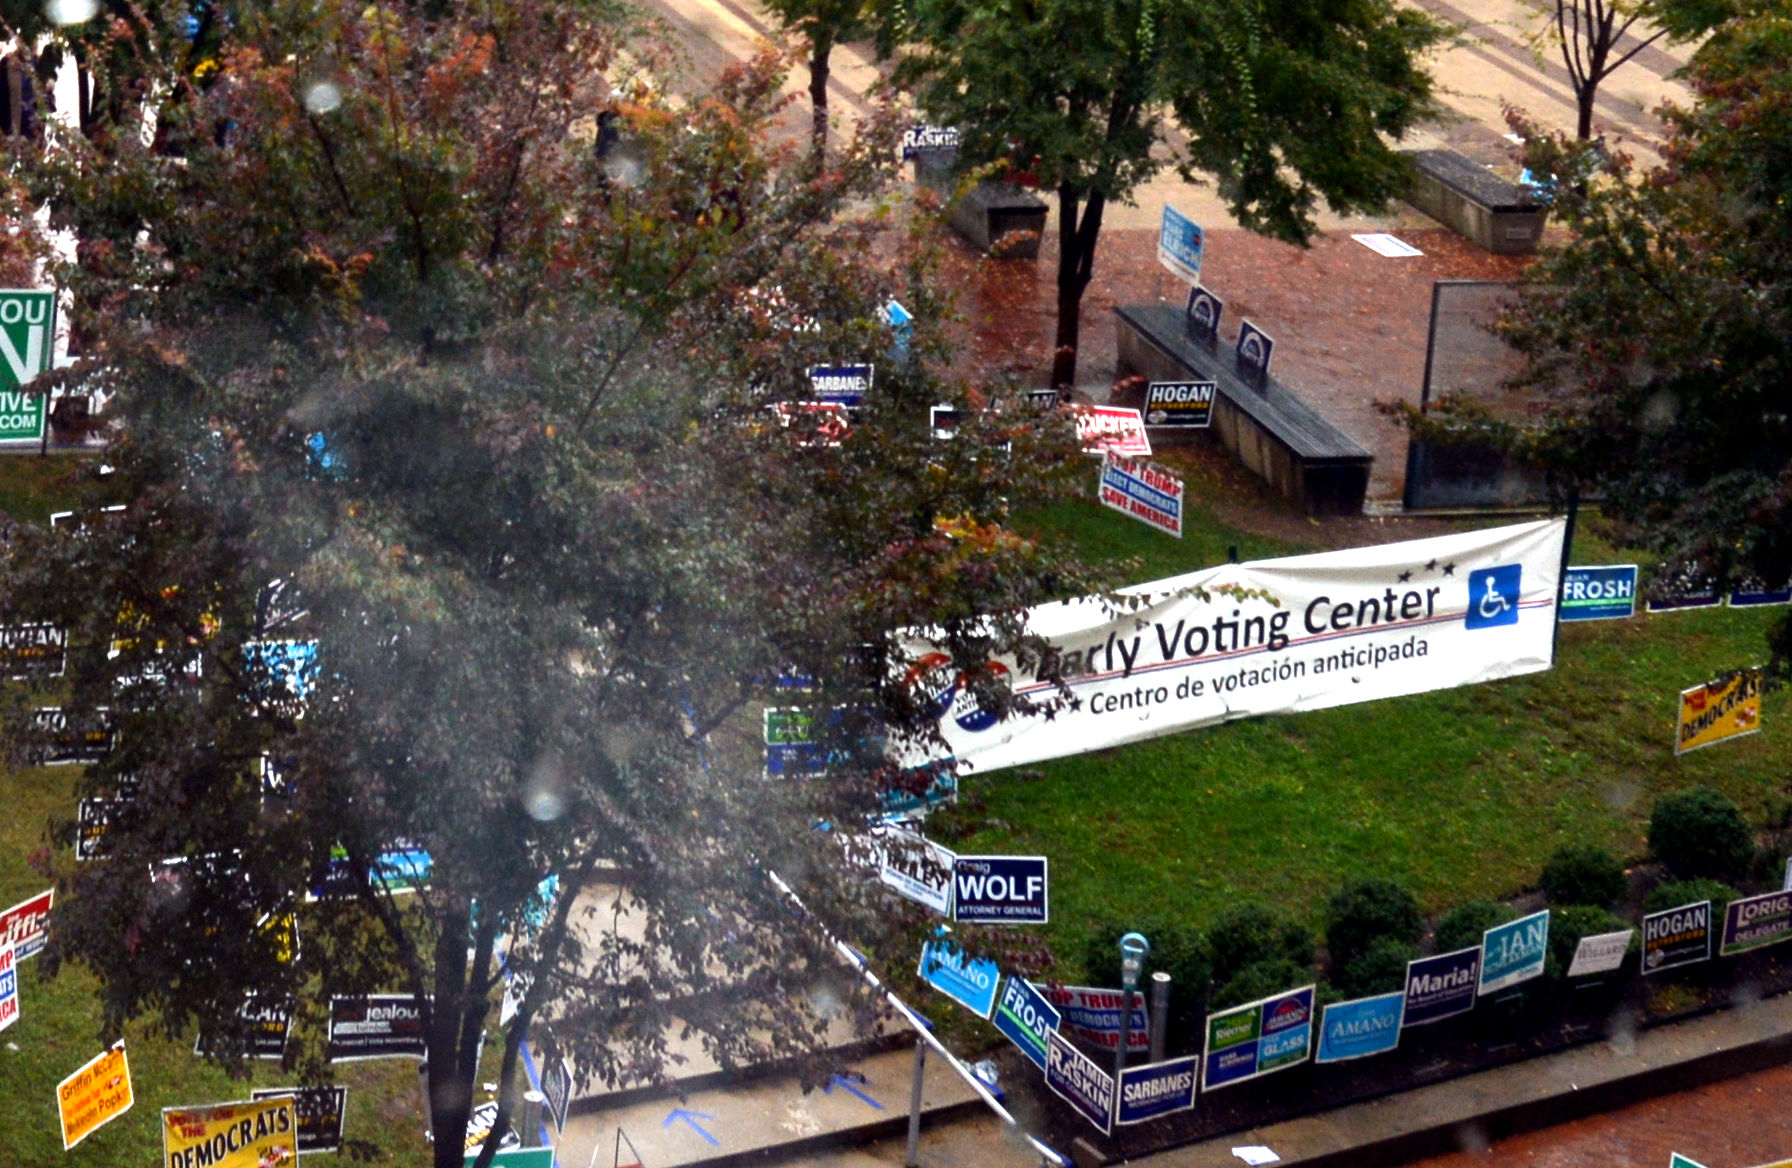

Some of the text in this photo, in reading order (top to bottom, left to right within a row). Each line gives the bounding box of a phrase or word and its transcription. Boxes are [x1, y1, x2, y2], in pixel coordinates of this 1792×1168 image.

[1151, 386, 1211, 403] HOGAN
[1141, 467, 1181, 496] TRUMP
[1102, 486, 1179, 532] SAVE AMERICA
[1564, 580, 1631, 600] FROSH
[1155, 609, 1290, 660] Voting
[1304, 585, 1440, 634] Center
[1090, 635, 1428, 714] Centro de votación anticipada
[958, 876, 1042, 900] WOLF
[958, 906, 1043, 916] ATTORNEY GENERAL
[1647, 908, 1706, 940] HOGAN
[1409, 962, 1476, 996] Maria!
[1071, 1009, 1144, 1027] DEMOCRTS
[1332, 1013, 1396, 1038] AMANO
[1079, 1029, 1149, 1048] AMERCA
[1264, 1035, 1305, 1056] GLASS
[62, 1074, 92, 1101] Griffin
[1050, 1043, 1109, 1112] RASKIN
[1069, 1053, 1110, 1094] JAMIE
[1124, 1071, 1192, 1102] SARBANES
[171, 1107, 290, 1168] DEMOCRATS
